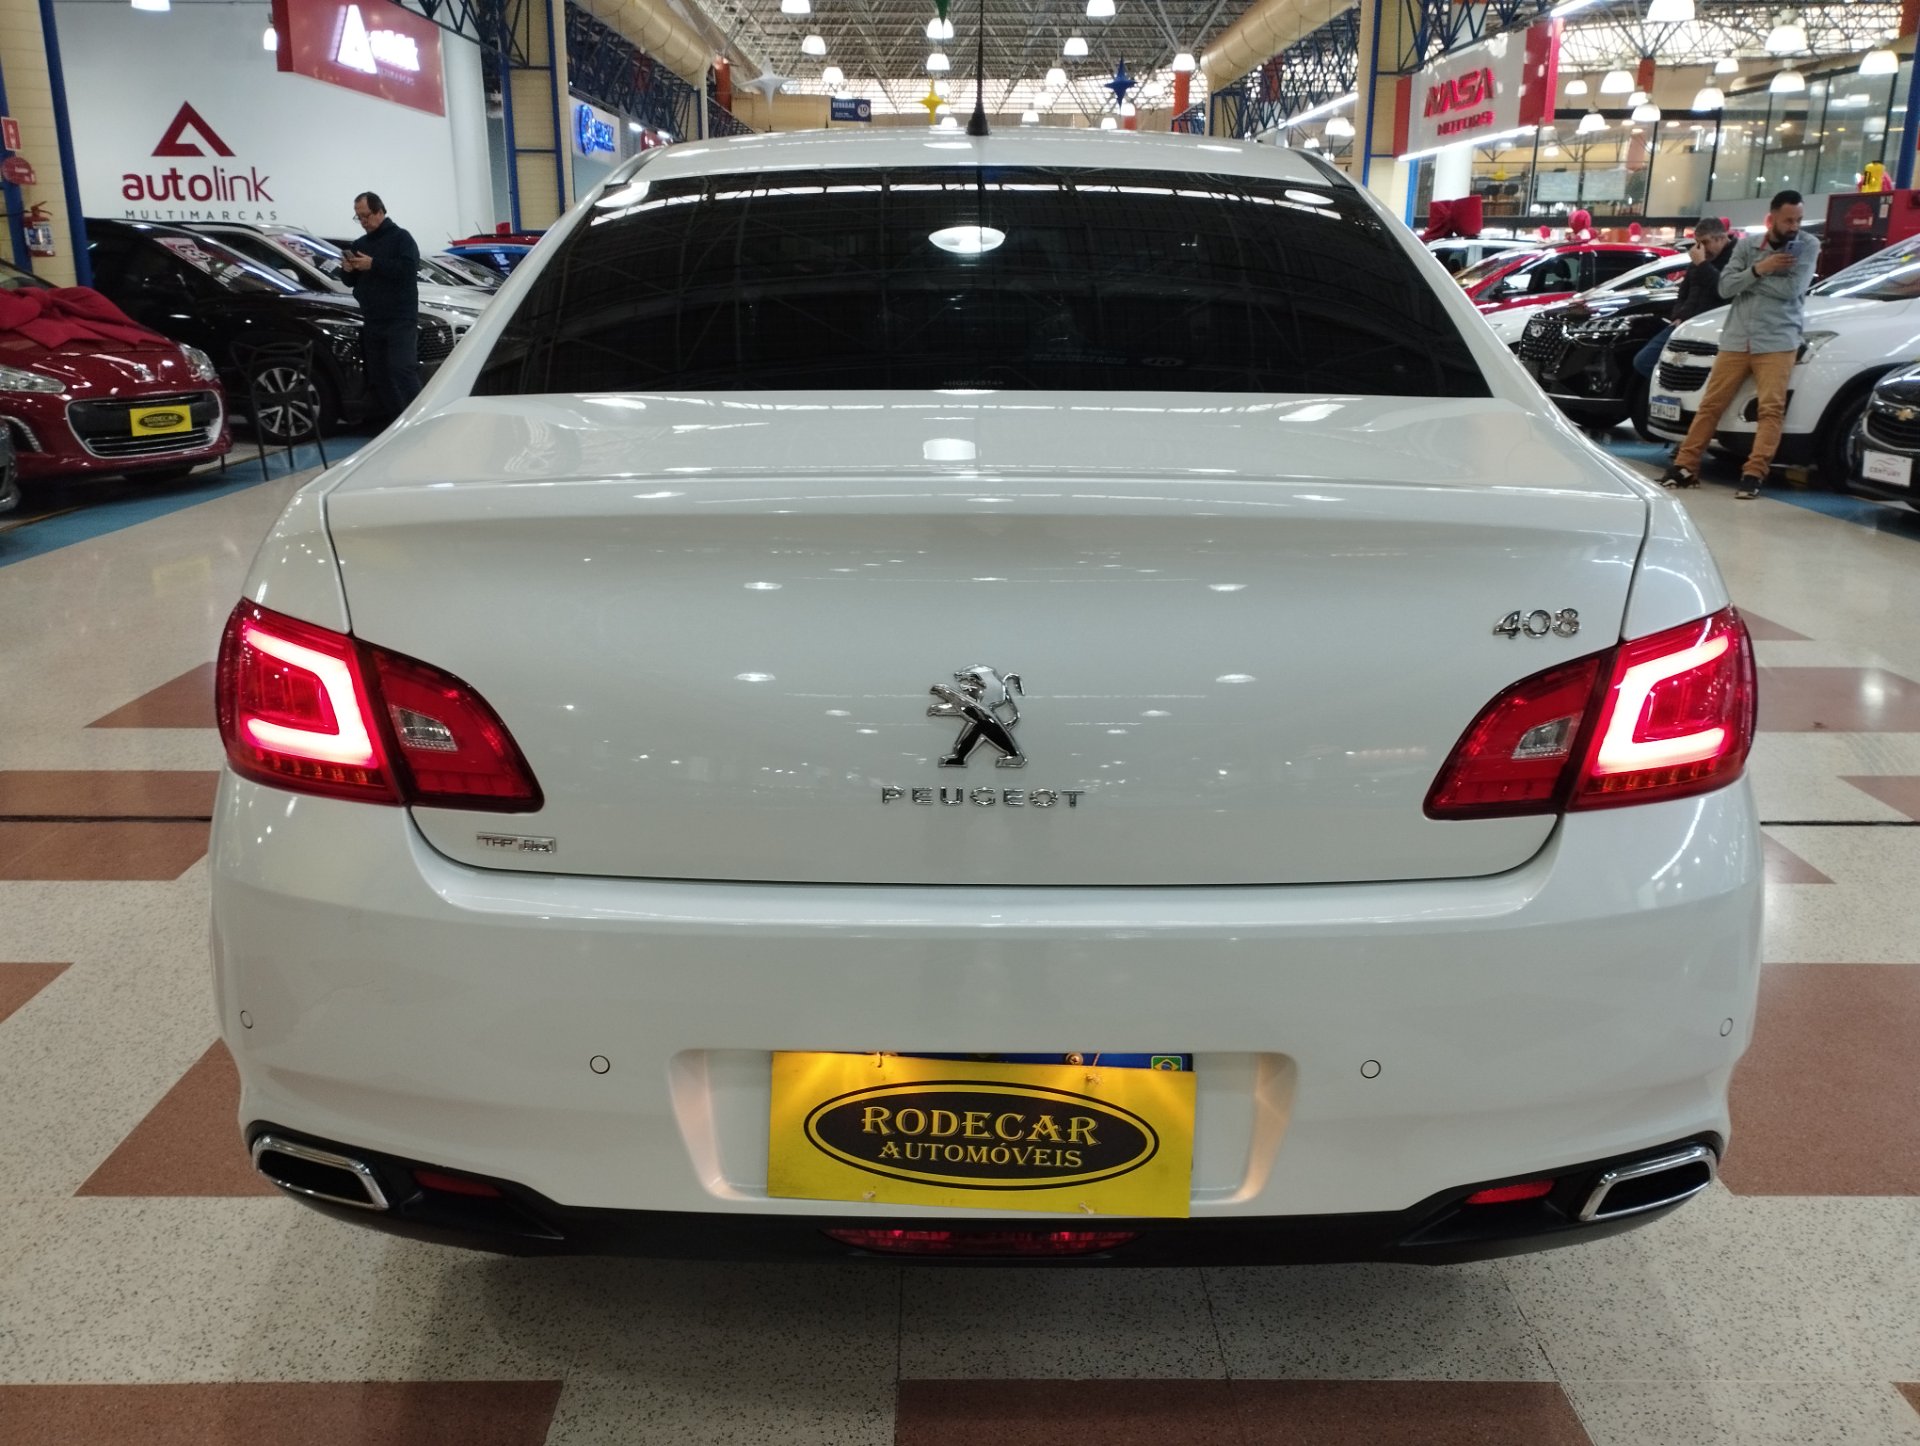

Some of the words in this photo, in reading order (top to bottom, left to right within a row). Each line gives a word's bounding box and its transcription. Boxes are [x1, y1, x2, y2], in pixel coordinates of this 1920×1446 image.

[1424, 67, 1494, 118] NASA
[1437, 111, 1494, 136] MOTORS
[122, 165, 274, 202] autolink
[125, 210, 278, 221] MULTIMARCAS
[1493, 608, 1580, 640] 408
[881, 785, 1086, 808] PEUGEOT
[861, 1106, 1101, 1147] RODECAR
[878, 1141, 1083, 1168] AUTOMÓVEIS
